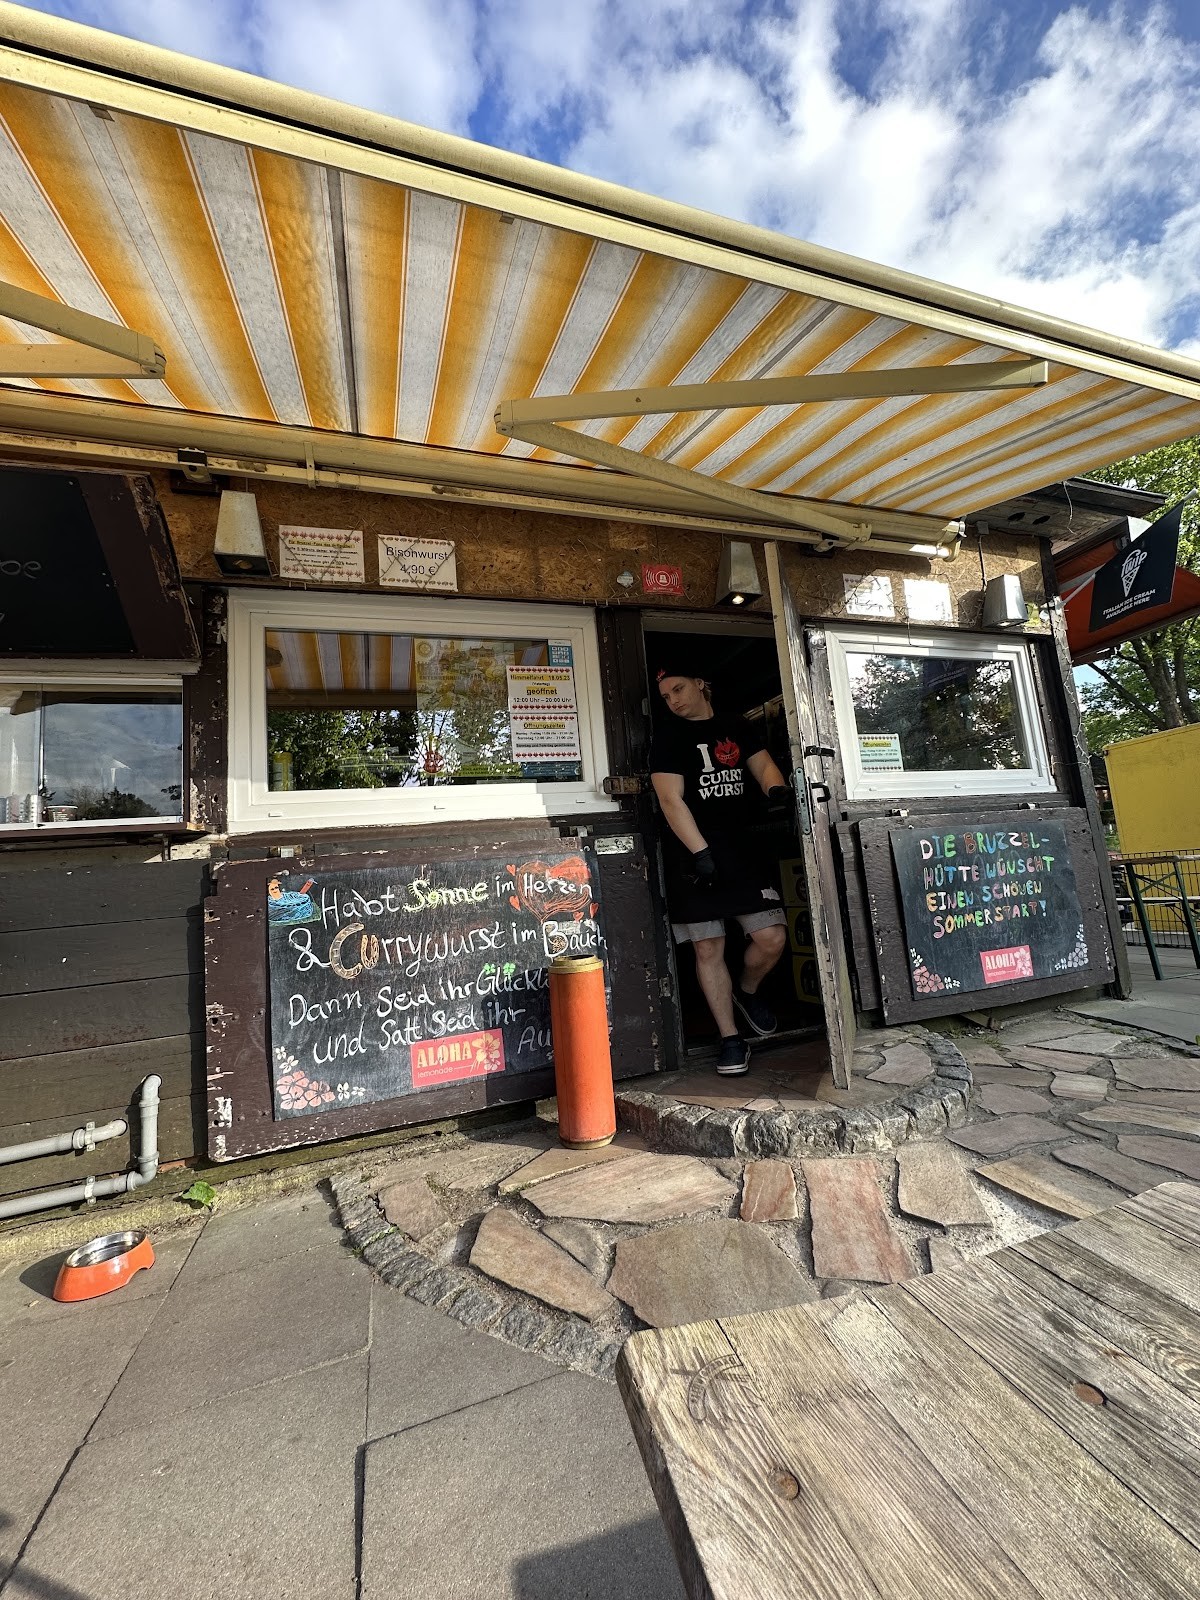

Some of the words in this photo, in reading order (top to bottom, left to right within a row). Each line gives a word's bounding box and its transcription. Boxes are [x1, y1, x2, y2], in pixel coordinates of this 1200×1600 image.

[386, 546, 449, 561] Bisonwurst
[428, 565, 437, 576] €
[1133, 589, 1156, 601] CREAM
[1133, 596, 1151, 607] HERE
[526, 687, 558, 696] geöffnet
[696, 743, 715, 773] I
[699, 768, 744, 787] CURRY
[697, 782, 745, 800] WURST
[920, 834, 957, 860] DIE
[923, 864, 981, 891] HÜTTE
[321, 885, 400, 930] Habt
[403, 876, 490, 912] Sonne
[496, 874, 516, 898] im
[523, 873, 594, 899] Herzen
[926, 891, 974, 912] EINEN
[329, 920, 507, 980] Currywurst
[512, 922, 538, 945] im
[542, 920, 609, 958] Bauch
[985, 952, 1016, 970] ALOHA
[288, 990, 364, 1030] Dann
[416, 1041, 473, 1069] ALOHA
[417, 1066, 454, 1079] lemonade
